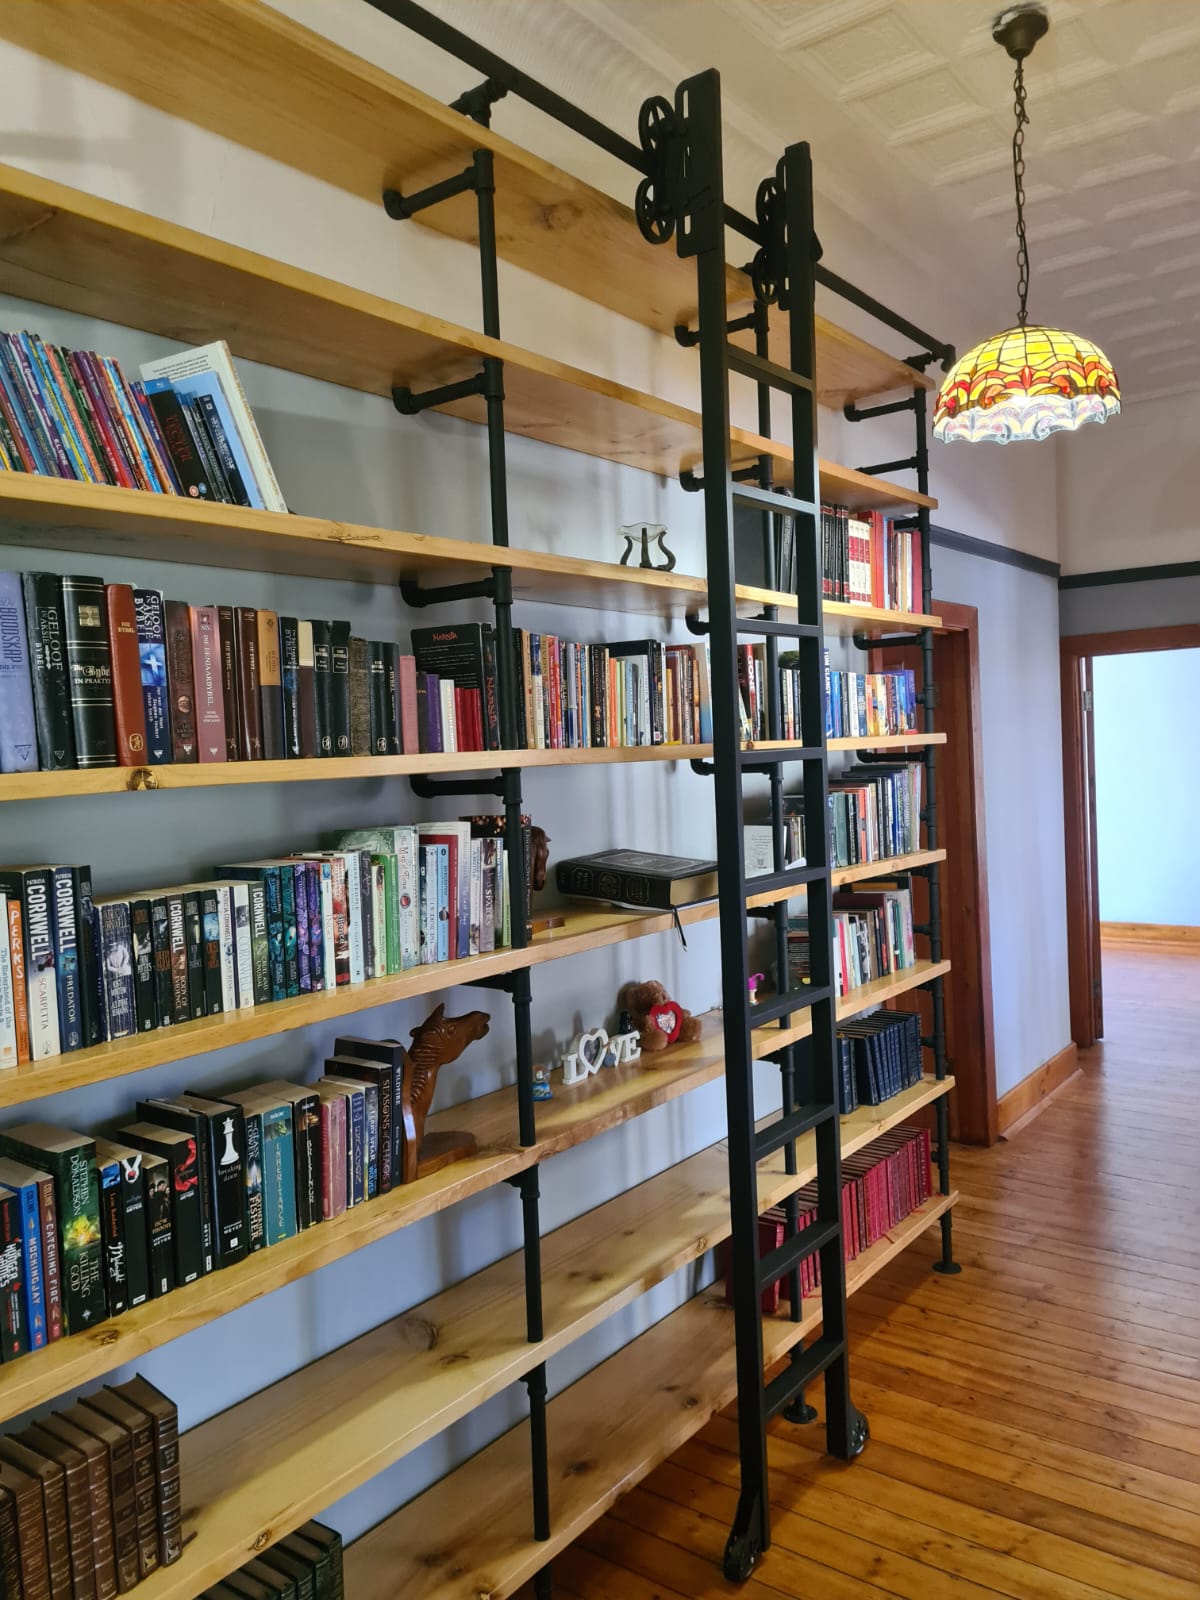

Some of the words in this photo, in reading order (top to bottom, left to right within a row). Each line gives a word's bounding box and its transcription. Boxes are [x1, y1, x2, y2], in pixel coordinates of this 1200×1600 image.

[41, 618, 50, 645] AKSIE
[48, 608, 63, 671] GELOOF
[144, 604, 154, 639] AKSIE
[150, 595, 161, 639] GELOOF
[35, 642, 43, 671] BYBEL
[85, 677, 111, 685] PRAKTY
[486, 676, 497, 729] NARNIA
[399, 846, 409, 864] Map
[28, 884, 51, 961] CORNWELL
[56, 878, 77, 954] CORNWELL
[171, 904, 185, 954] CORNWELL
[253, 891, 266, 938] CORNWELL
[9, 911, 24, 979] PERKS
[38, 976, 49, 1030] SCARPETTA
[66, 975, 76, 1024] PREDATOR
[382, 1079, 391, 1130] SEASONS
[394, 1066, 402, 1106] WILDFIRE
[247, 1122, 255, 1161] TOWER
[253, 1128, 261, 1158] GLASS
[382, 1141, 391, 1181] CHAOS
[43, 1182, 53, 1207] COLLINS
[70, 1154, 81, 1217] DONALDSON
[79, 1159, 90, 1205] STEPHEN
[223, 1224, 243, 1235] MEYER
[249, 1195, 259, 1242] FISHER
[6, 1243, 18, 1280] HUNGER
[28, 1236, 41, 1305] MOCKINGJAY
[45, 1223, 57, 1276] CATCHING
[89, 1257, 100, 1282] THE
[50, 1279, 60, 1304] FIRE
[70, 1263, 81, 1292] GOD
[79, 1251, 91, 1299] KILLING
